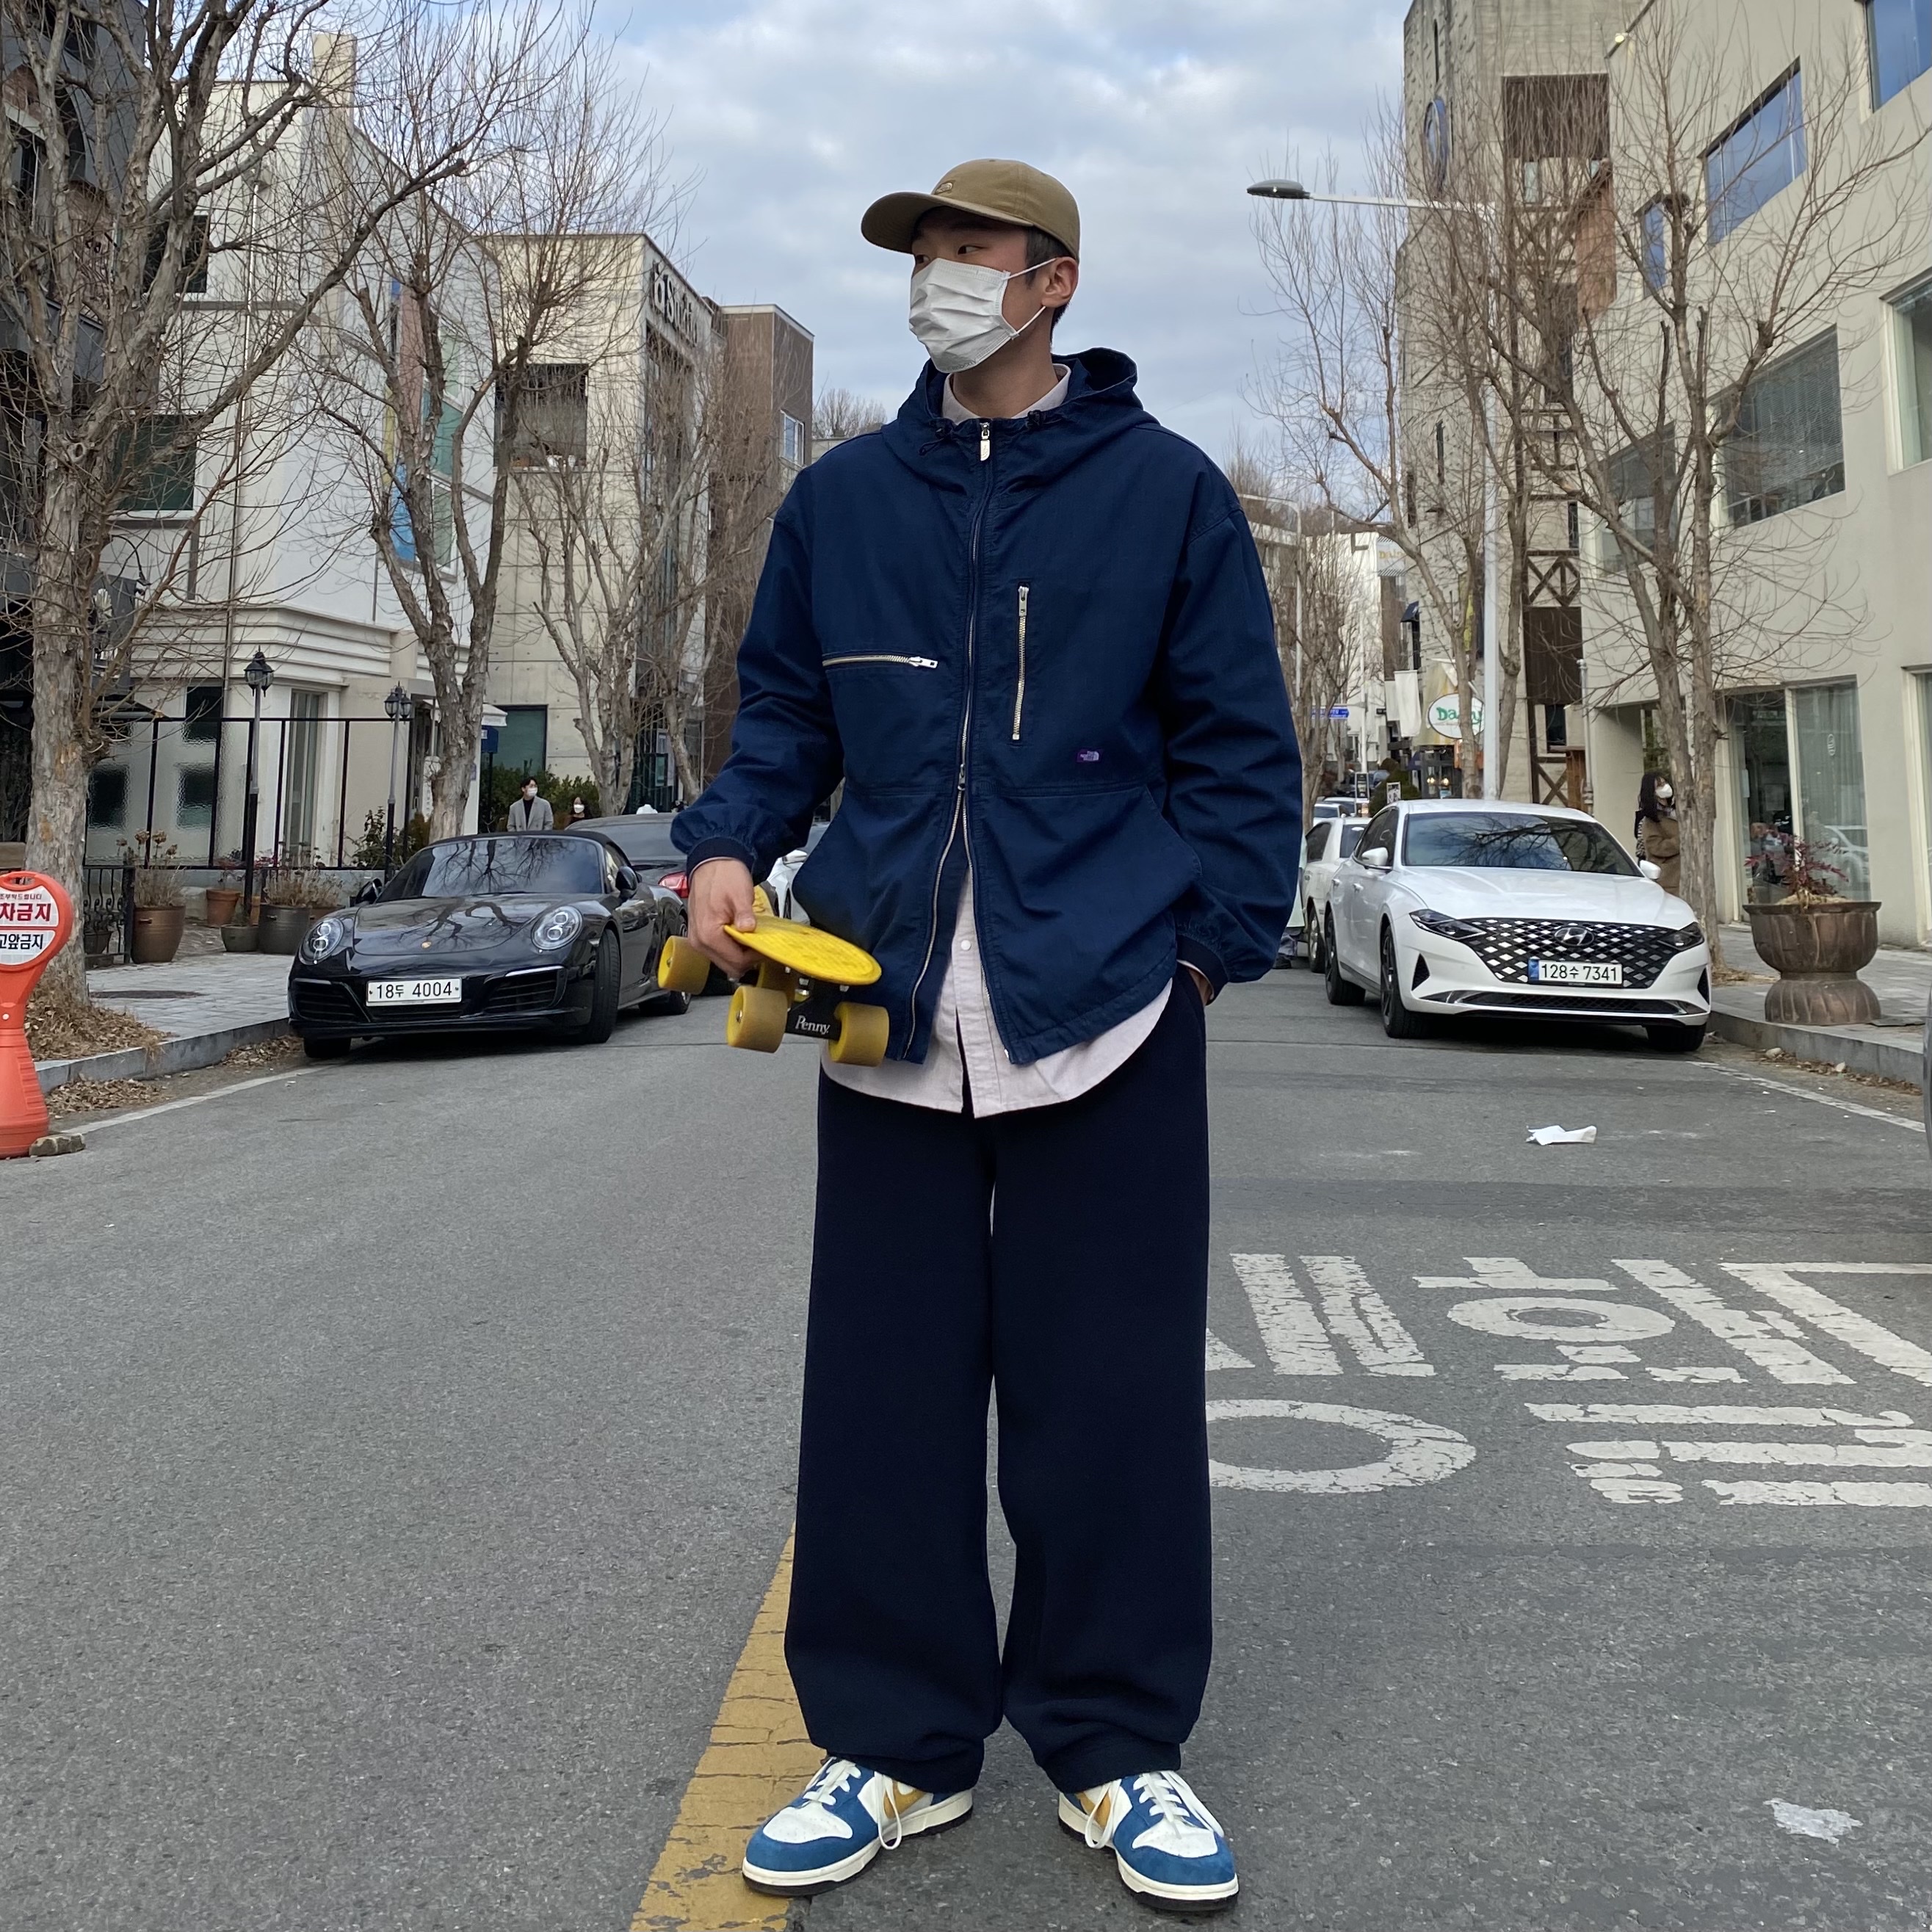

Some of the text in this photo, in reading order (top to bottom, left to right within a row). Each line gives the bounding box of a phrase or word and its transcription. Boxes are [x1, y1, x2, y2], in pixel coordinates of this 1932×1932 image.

[0, 902, 51, 921] 차금지
[1541, 963, 1616, 981] 128수 7341
[377, 981, 452, 999] 18두 4004
